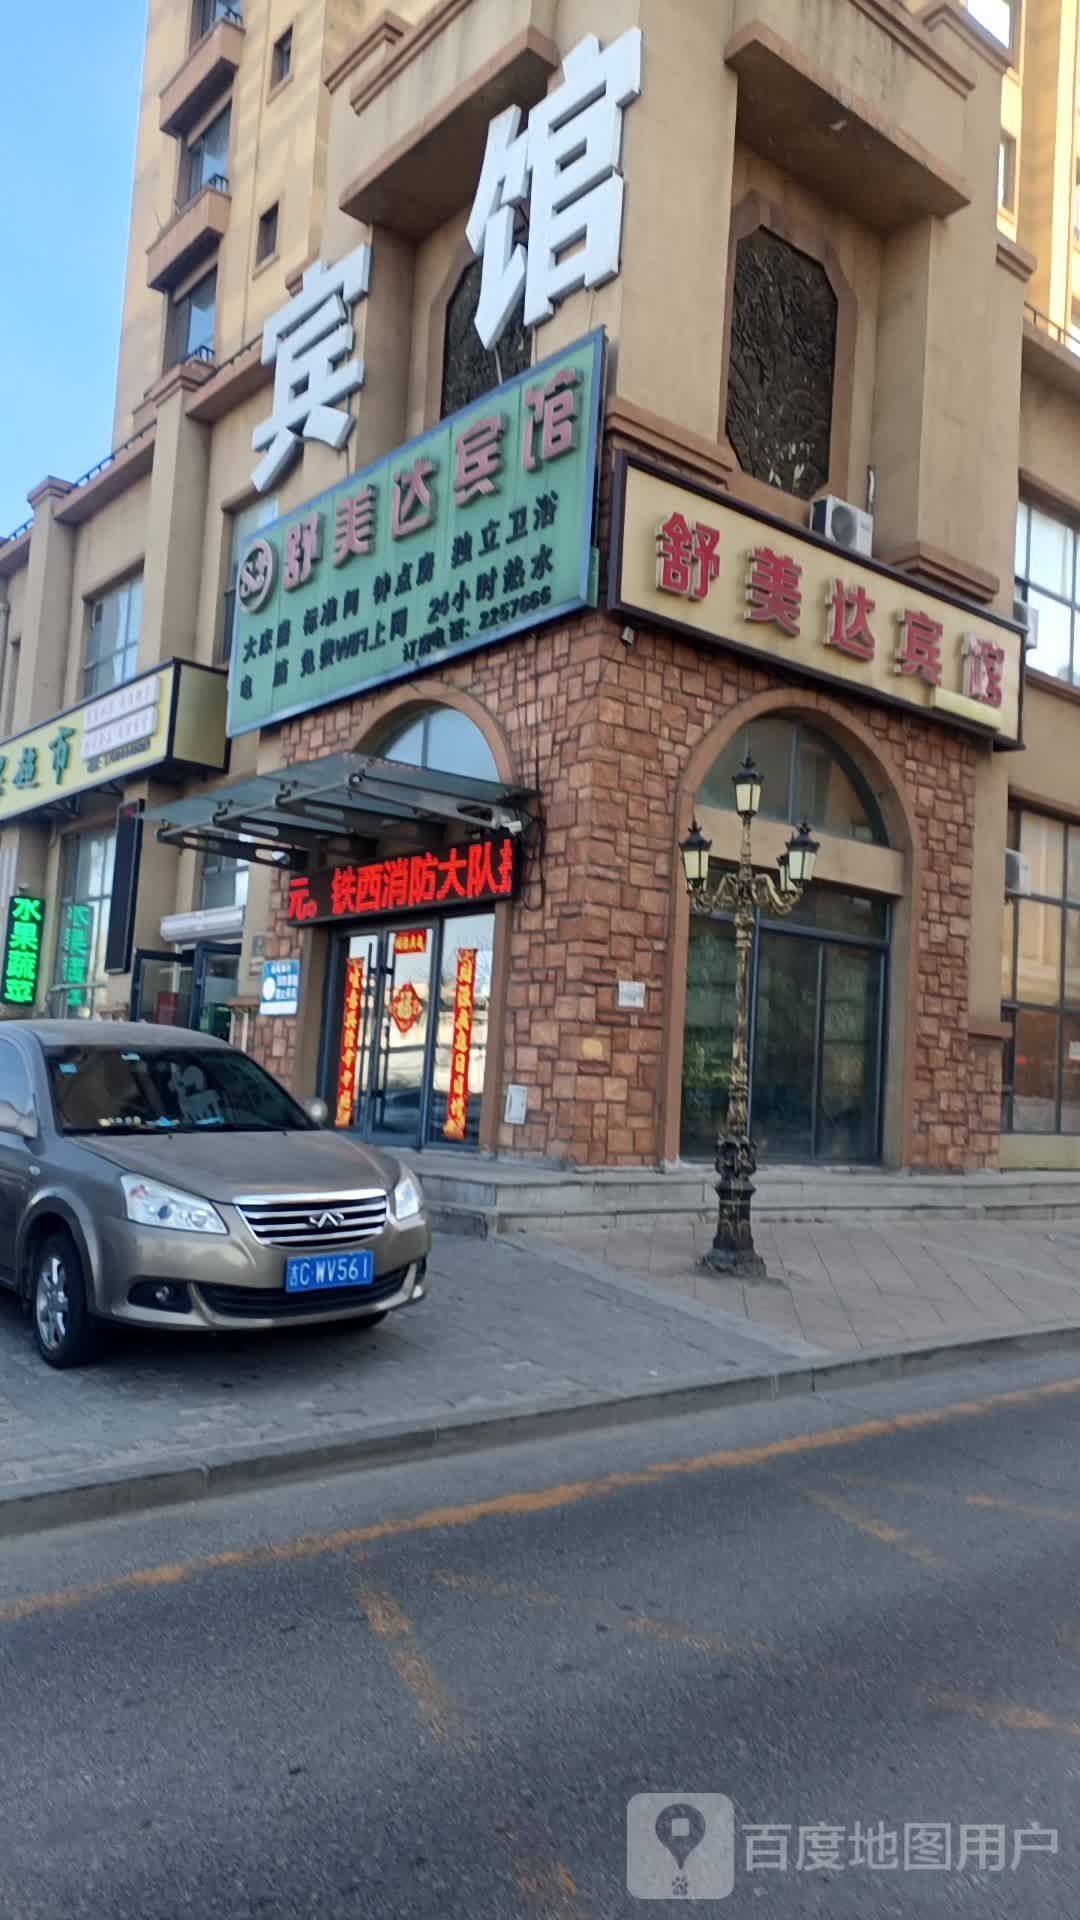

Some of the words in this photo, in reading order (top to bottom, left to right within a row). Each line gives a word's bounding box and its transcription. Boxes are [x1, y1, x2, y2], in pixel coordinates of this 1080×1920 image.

[251, 27, 642, 491] 宾馆
[283, 368, 582, 592] 舒美达宾馆
[452, 490, 559, 569] 独立卫浴
[655, 512, 1005, 707] 舒美达宾馆
